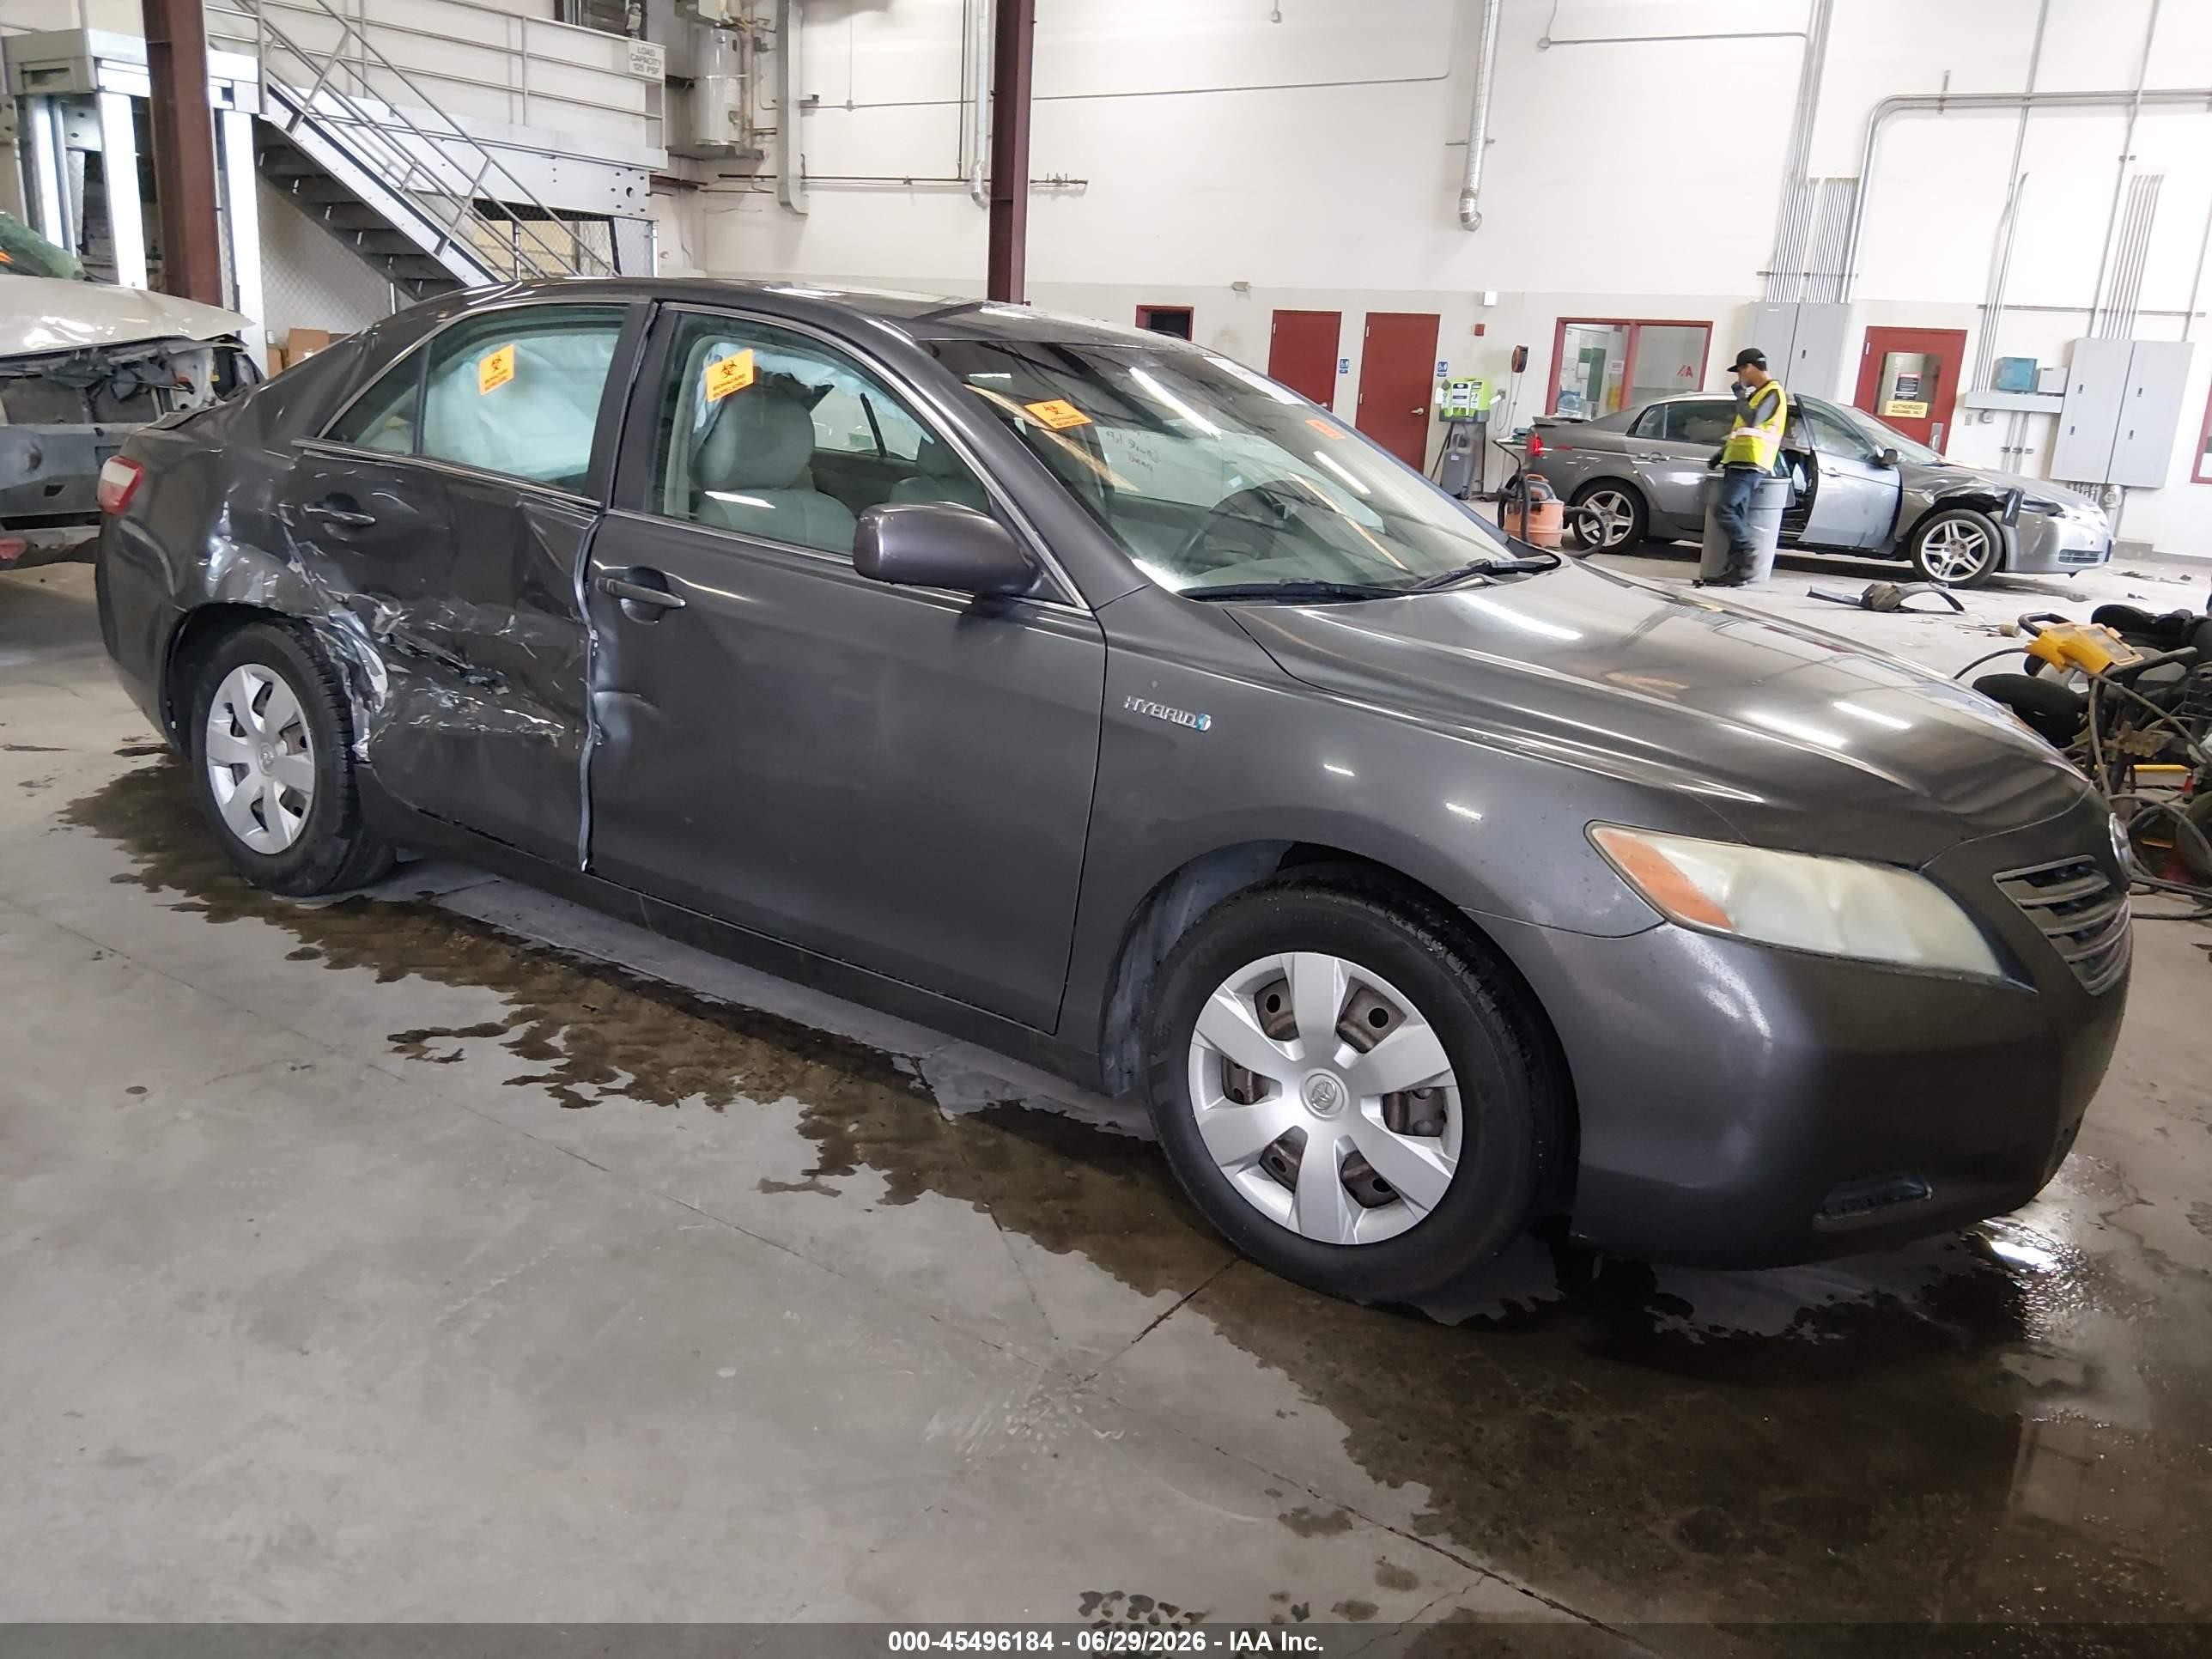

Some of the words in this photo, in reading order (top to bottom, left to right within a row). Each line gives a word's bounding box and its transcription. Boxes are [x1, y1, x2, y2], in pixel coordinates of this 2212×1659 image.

[637, 46, 655, 57] LOAD
[630, 53, 661, 66] CAPACITY
[1123, 696, 1197, 729] HYBRID
